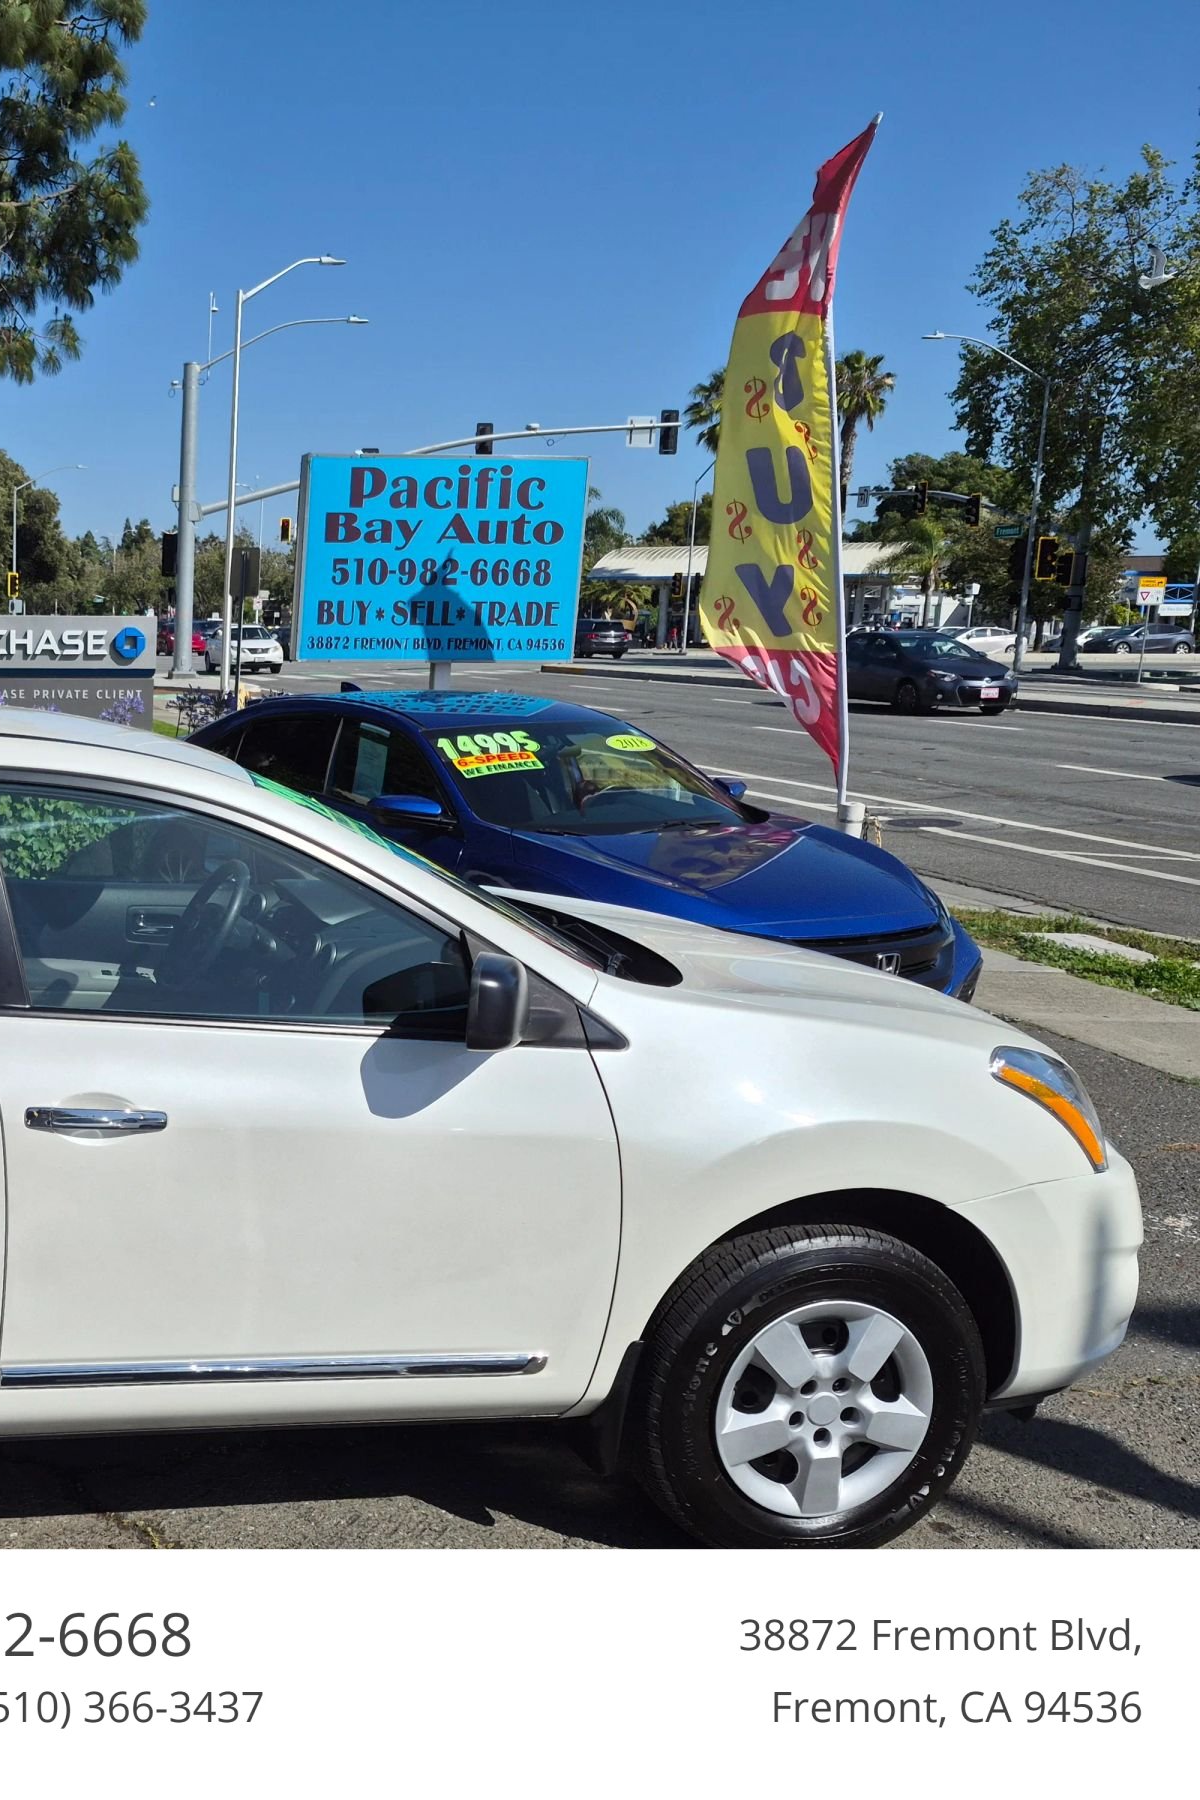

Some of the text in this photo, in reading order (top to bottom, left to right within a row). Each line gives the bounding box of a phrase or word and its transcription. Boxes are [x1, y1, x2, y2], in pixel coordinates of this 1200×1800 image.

[349, 465, 546, 510] Pacific
[324, 512, 564, 550] Bay Auto
[331, 558, 552, 586] 510-982-6668
[317, 600, 560, 627] BUY SELL TRADE
[307, 636, 350, 650] 38872
[353, 637, 410, 650] FREMONT
[507, 638, 523, 650] CA
[526, 638, 565, 650] 94536
[33, 689, 89, 699] PRIVATE
[96, 689, 143, 699] CLIENT
[437, 731, 540, 760] 14995
[457, 752, 532, 767] 6-SPEED
[464, 760, 540, 776] WE FINANCE
